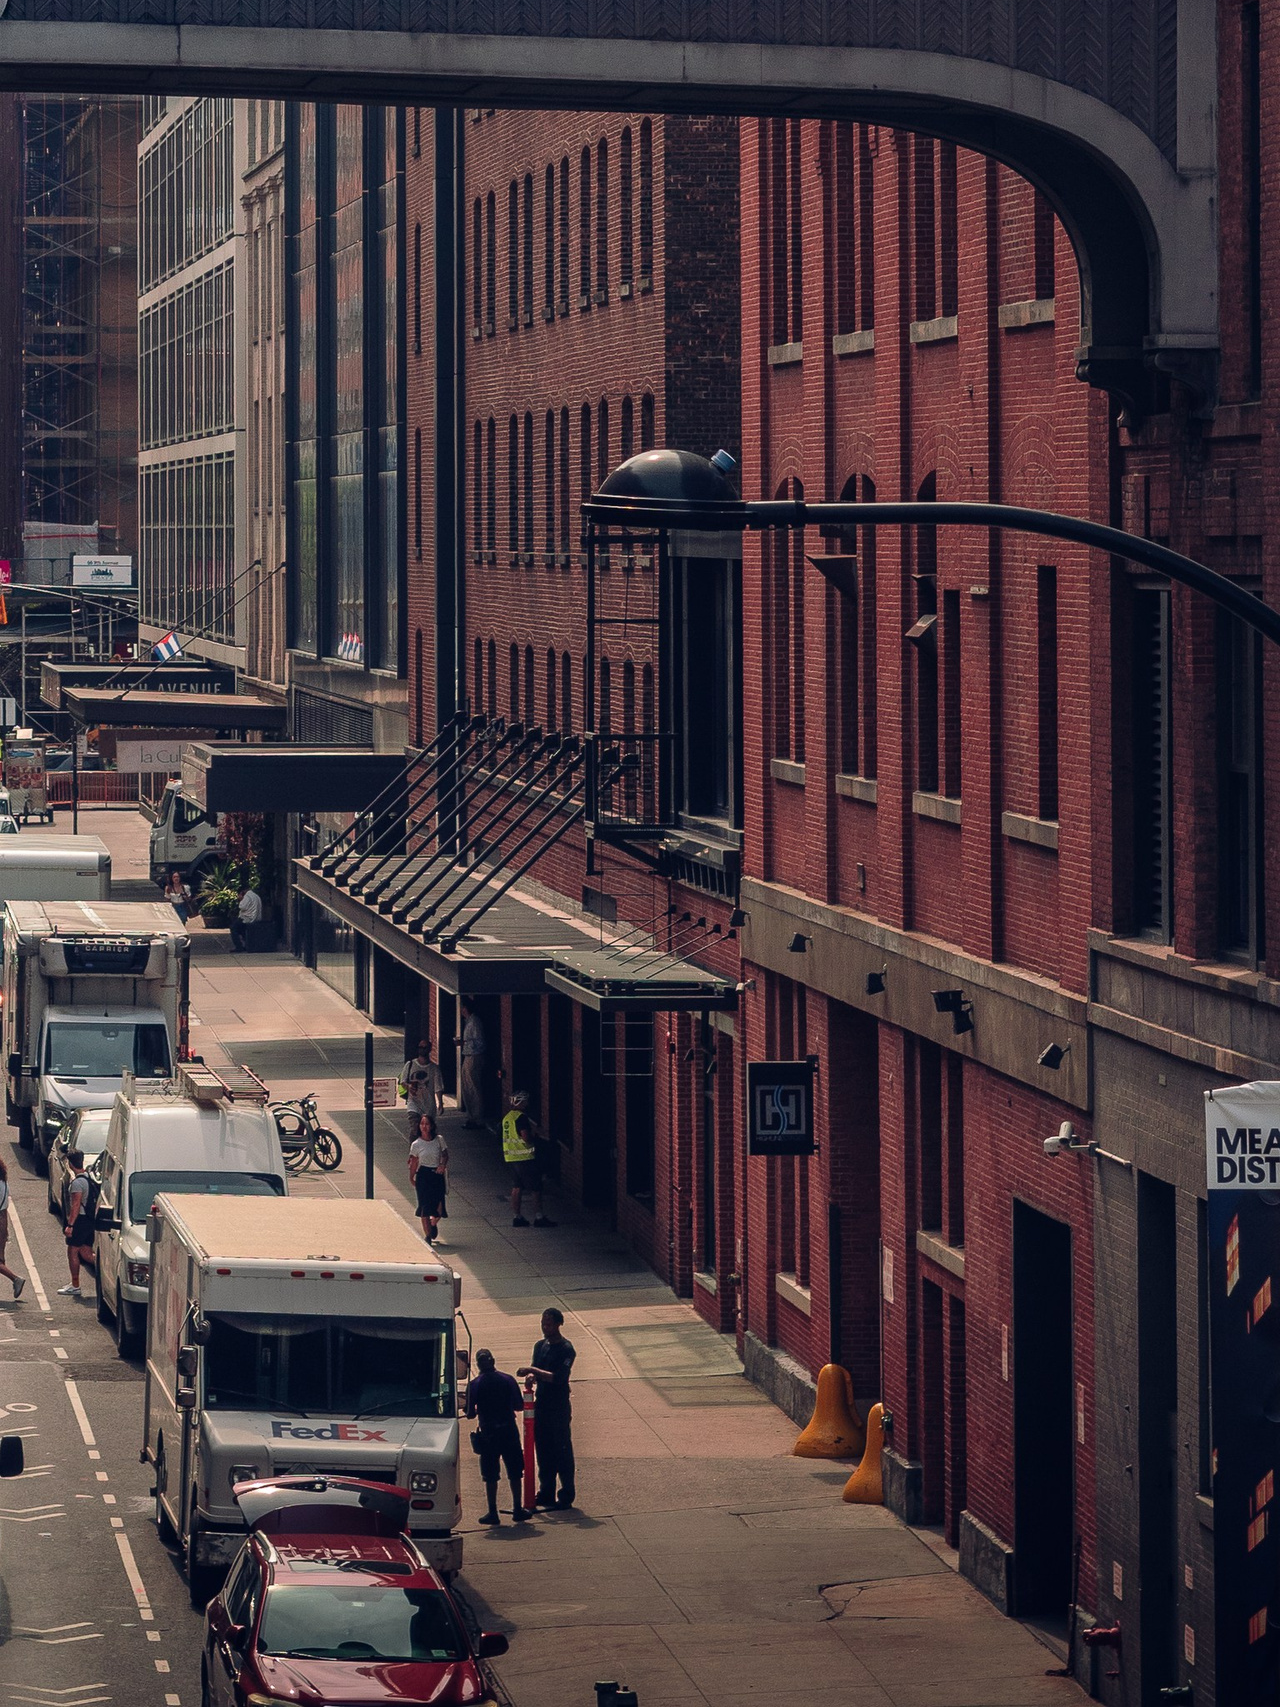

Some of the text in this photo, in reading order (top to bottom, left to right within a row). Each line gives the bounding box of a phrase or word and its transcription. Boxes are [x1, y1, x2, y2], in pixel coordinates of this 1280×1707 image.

[140, 746, 153, 764] la
[85, 945, 129, 953] CARRIER
[1216, 1128, 1280, 1154] MEA
[1217, 1156, 1280, 1183] DIST
[271, 1421, 389, 1442] FedEx
